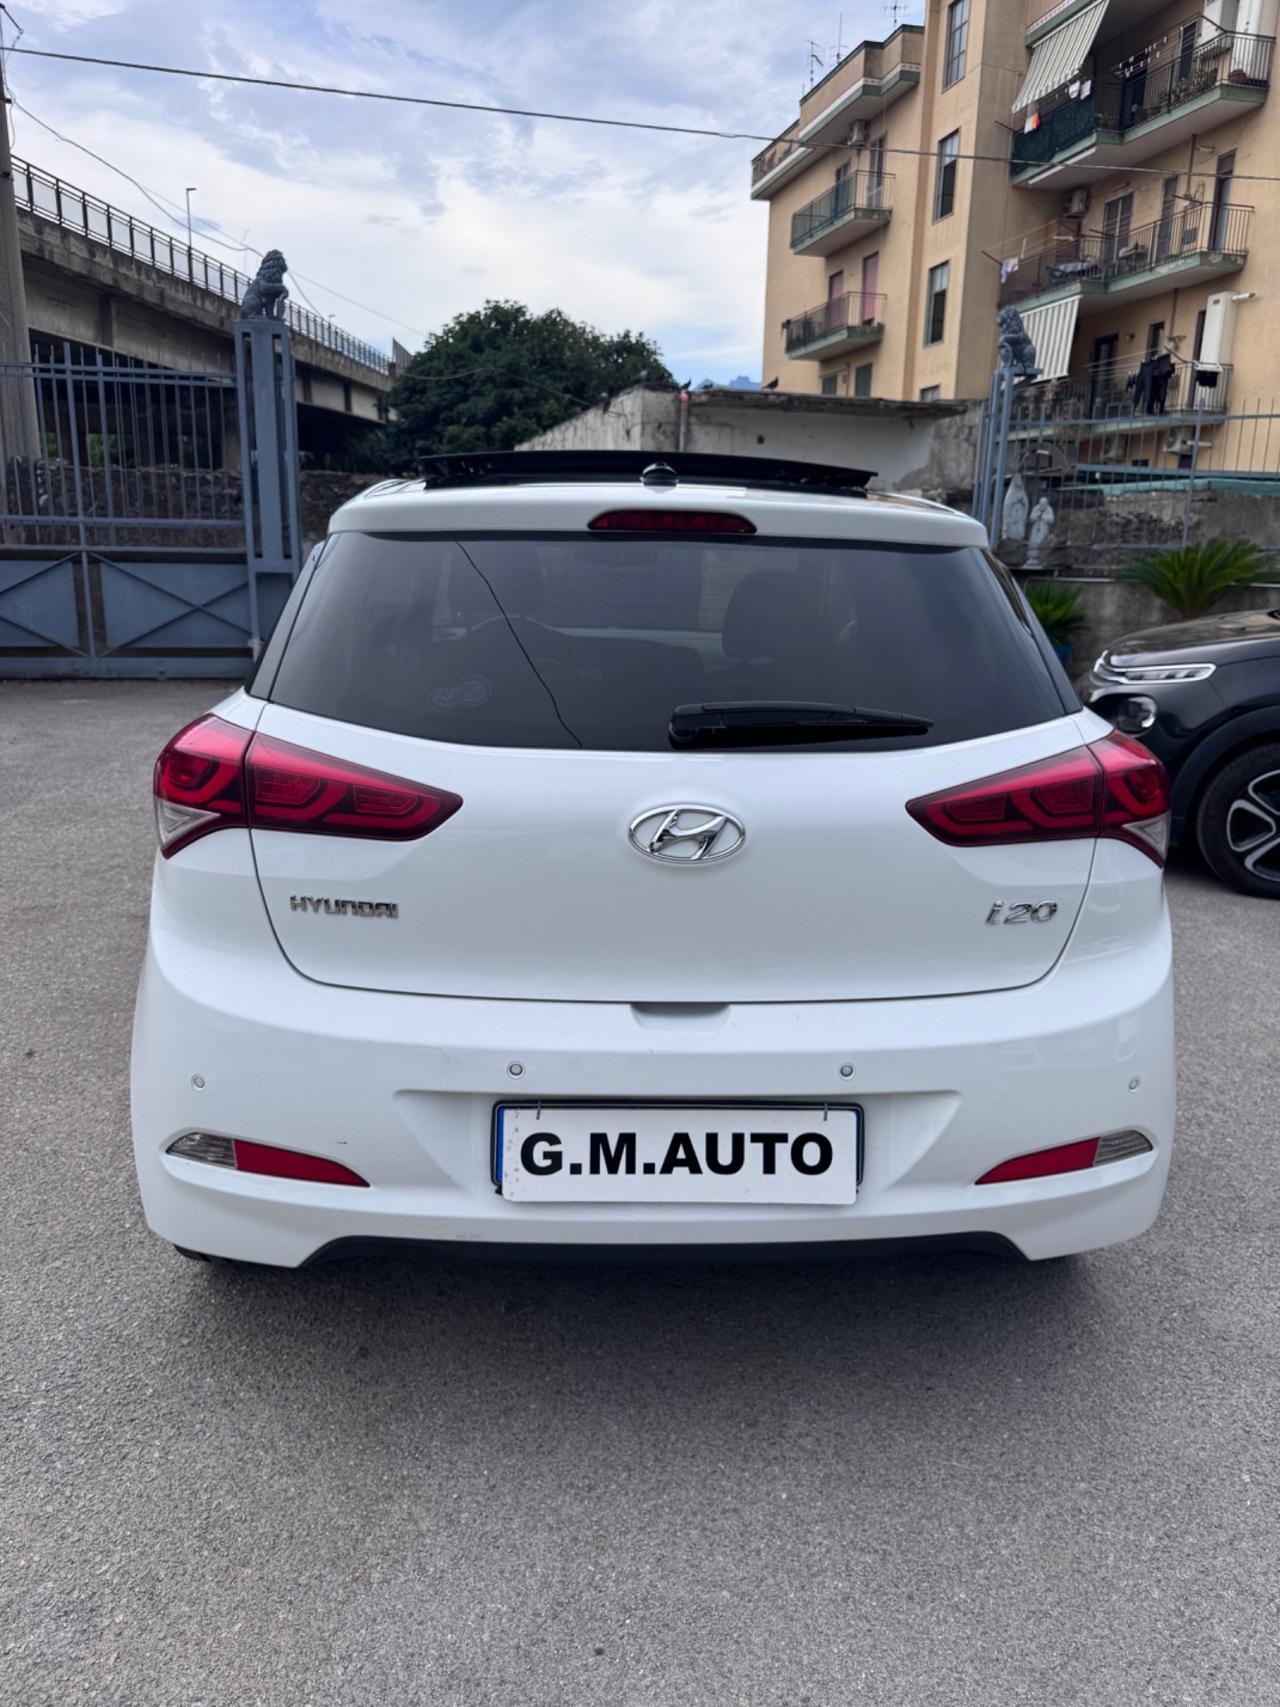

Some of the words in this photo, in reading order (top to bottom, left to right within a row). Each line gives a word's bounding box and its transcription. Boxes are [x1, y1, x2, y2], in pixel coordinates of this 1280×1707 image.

[290, 895, 398, 919] HYUNDAI
[985, 900, 1058, 925] i20
[520, 1132, 833, 1175] G.M.AUTO
